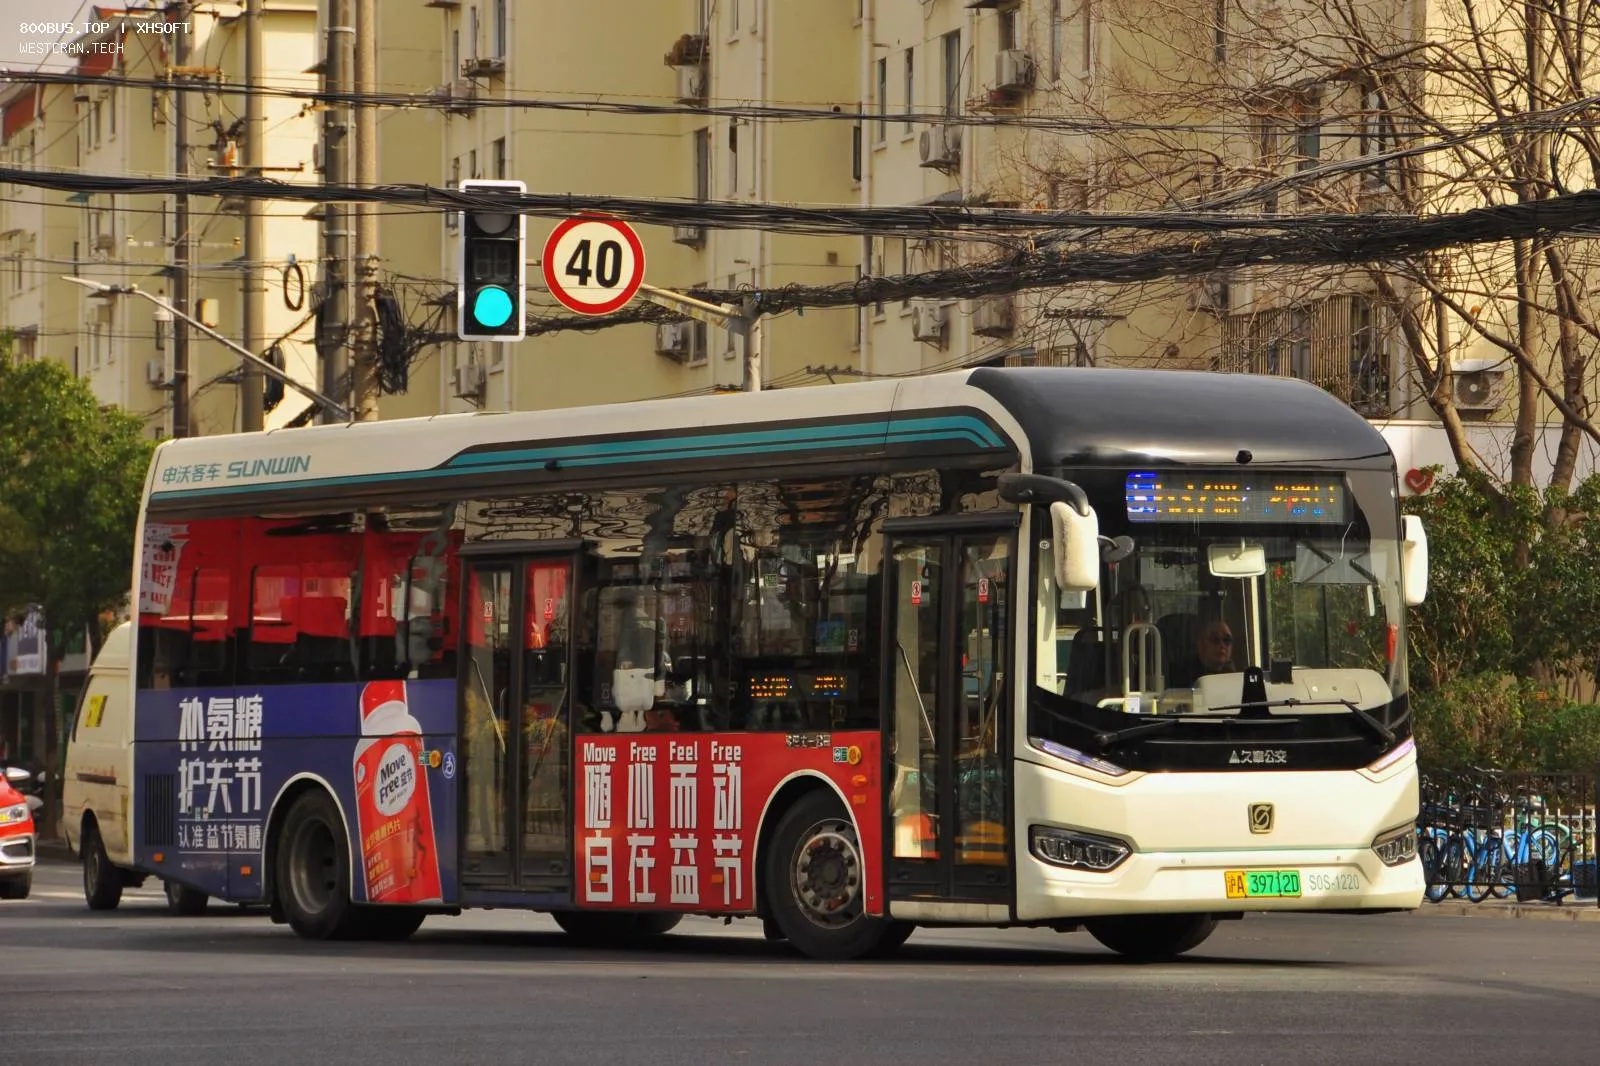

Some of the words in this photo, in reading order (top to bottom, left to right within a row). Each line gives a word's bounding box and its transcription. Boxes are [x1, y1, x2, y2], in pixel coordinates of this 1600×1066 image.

[565, 239, 623, 288] 40
[162, 463, 222, 485] 申沃客车
[226, 455, 311, 479] SUNWIN
[178, 694, 264, 752] 补氨糖
[381, 754, 406, 783] Move
[584, 743, 616, 762] Move
[630, 742, 657, 761] Free
[669, 741, 698, 761] Feel
[711, 741, 741, 761] Free
[178, 757, 263, 814] 护关节
